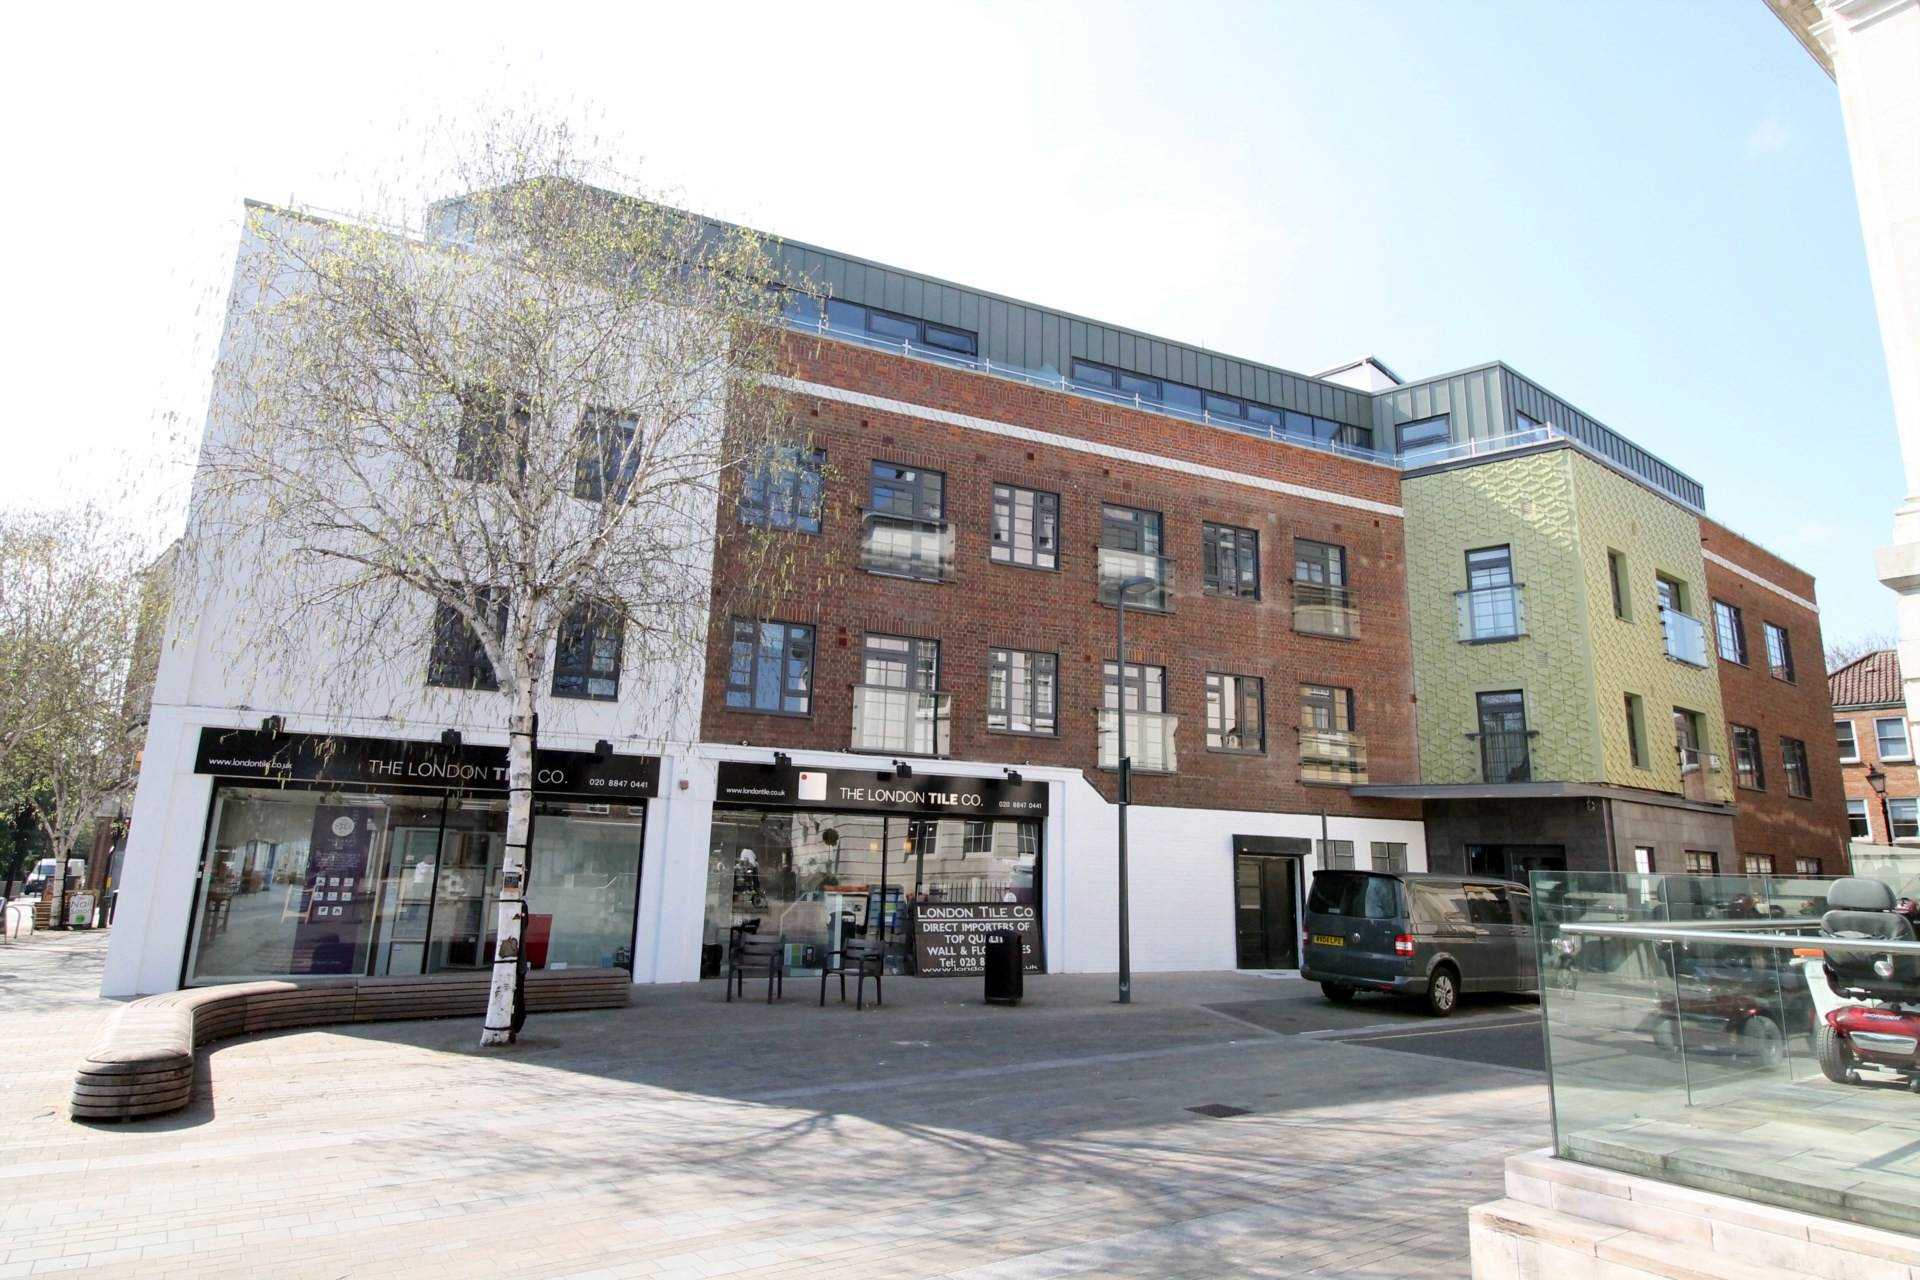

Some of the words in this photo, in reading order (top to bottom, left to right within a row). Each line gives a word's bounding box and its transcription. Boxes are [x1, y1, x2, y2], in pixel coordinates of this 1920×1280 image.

[208, 757, 293, 769] www.londontile.co.uk
[369, 760, 404, 775] THE
[408, 762, 489, 780] LONDON
[537, 769, 569, 784] CO.
[589, 778, 605, 786] 020
[608, 779, 628, 788] 8847
[630, 780, 649, 789] 0441
[726, 787, 785, 796] www.londontile.co.uk
[840, 787, 865, 801] THE
[868, 789, 925, 804] LONDON
[928, 792, 959, 806] TILE
[961, 793, 984, 807] CO.
[1012, 801, 1027, 809] 8847
[917, 906, 974, 918] LONDON
[979, 905, 1008, 918] TILE
[923, 922, 958, 933] DIRECT
[961, 922, 1015, 932] IMPORTERS
[1017, 922, 1031, 932] OF
[944, 934, 965, 944] TOP
[926, 946, 957, 957] WALL
[959, 945, 968, 956] &
[940, 958, 957, 968] Tel:
[959, 957, 977, 967] 020
